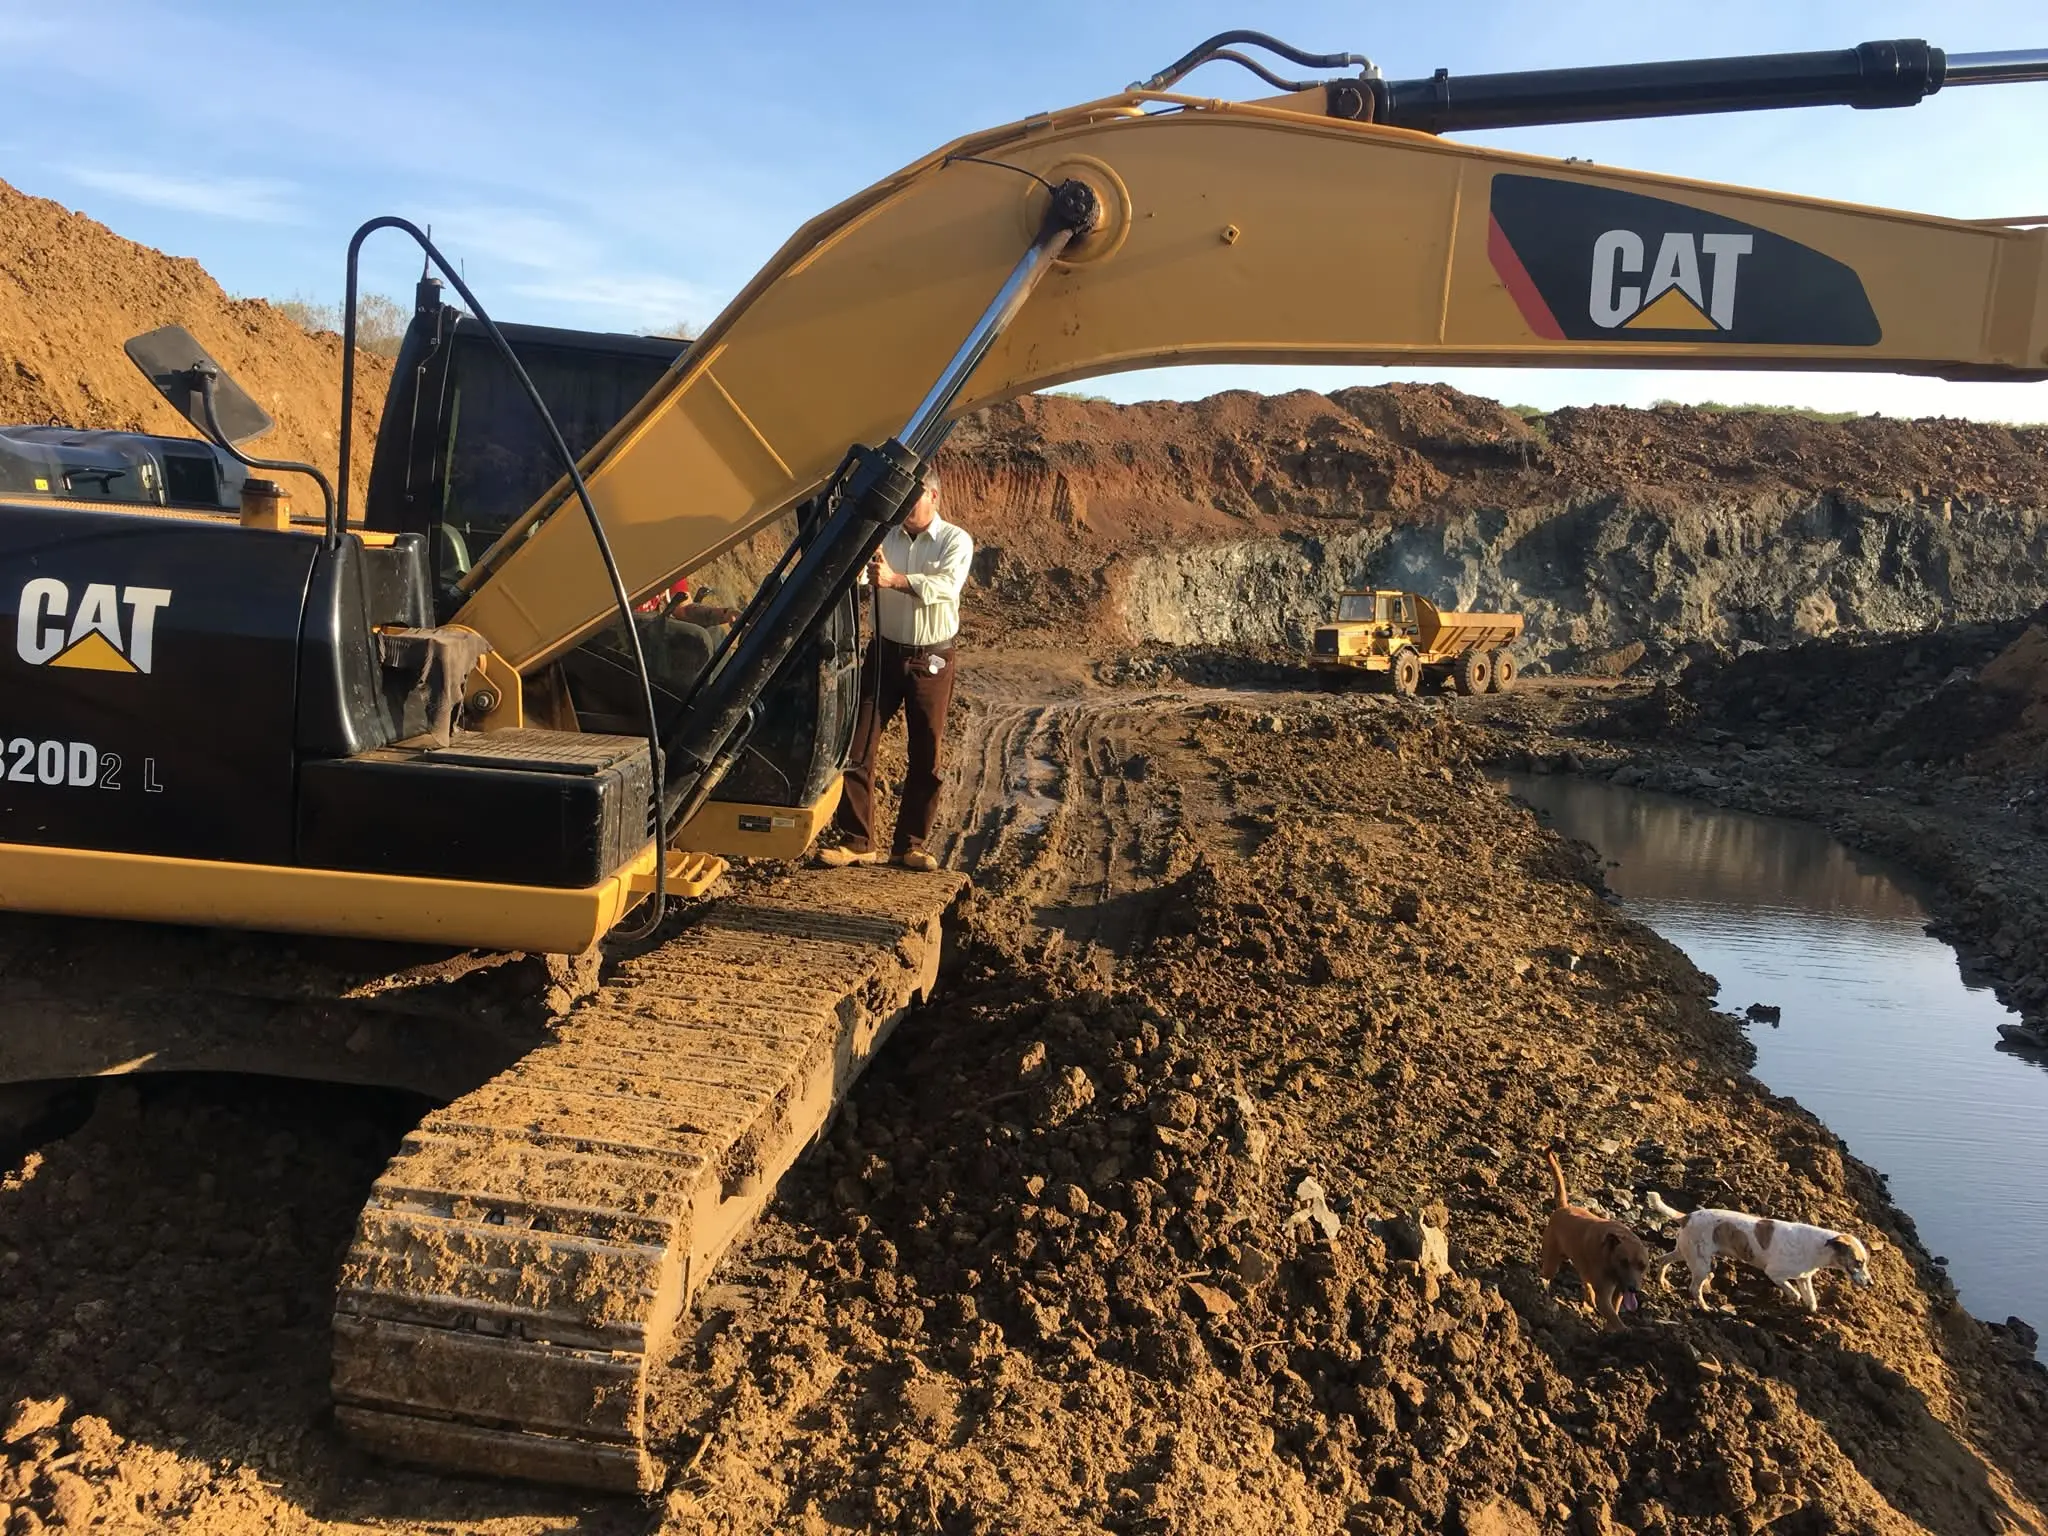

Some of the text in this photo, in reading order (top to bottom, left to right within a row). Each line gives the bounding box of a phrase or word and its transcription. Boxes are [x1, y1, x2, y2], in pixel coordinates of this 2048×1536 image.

[1589, 229, 1753, 331] CAT
[16, 577, 172, 674] CAT
[0, 737, 164, 792] 20D2 L
